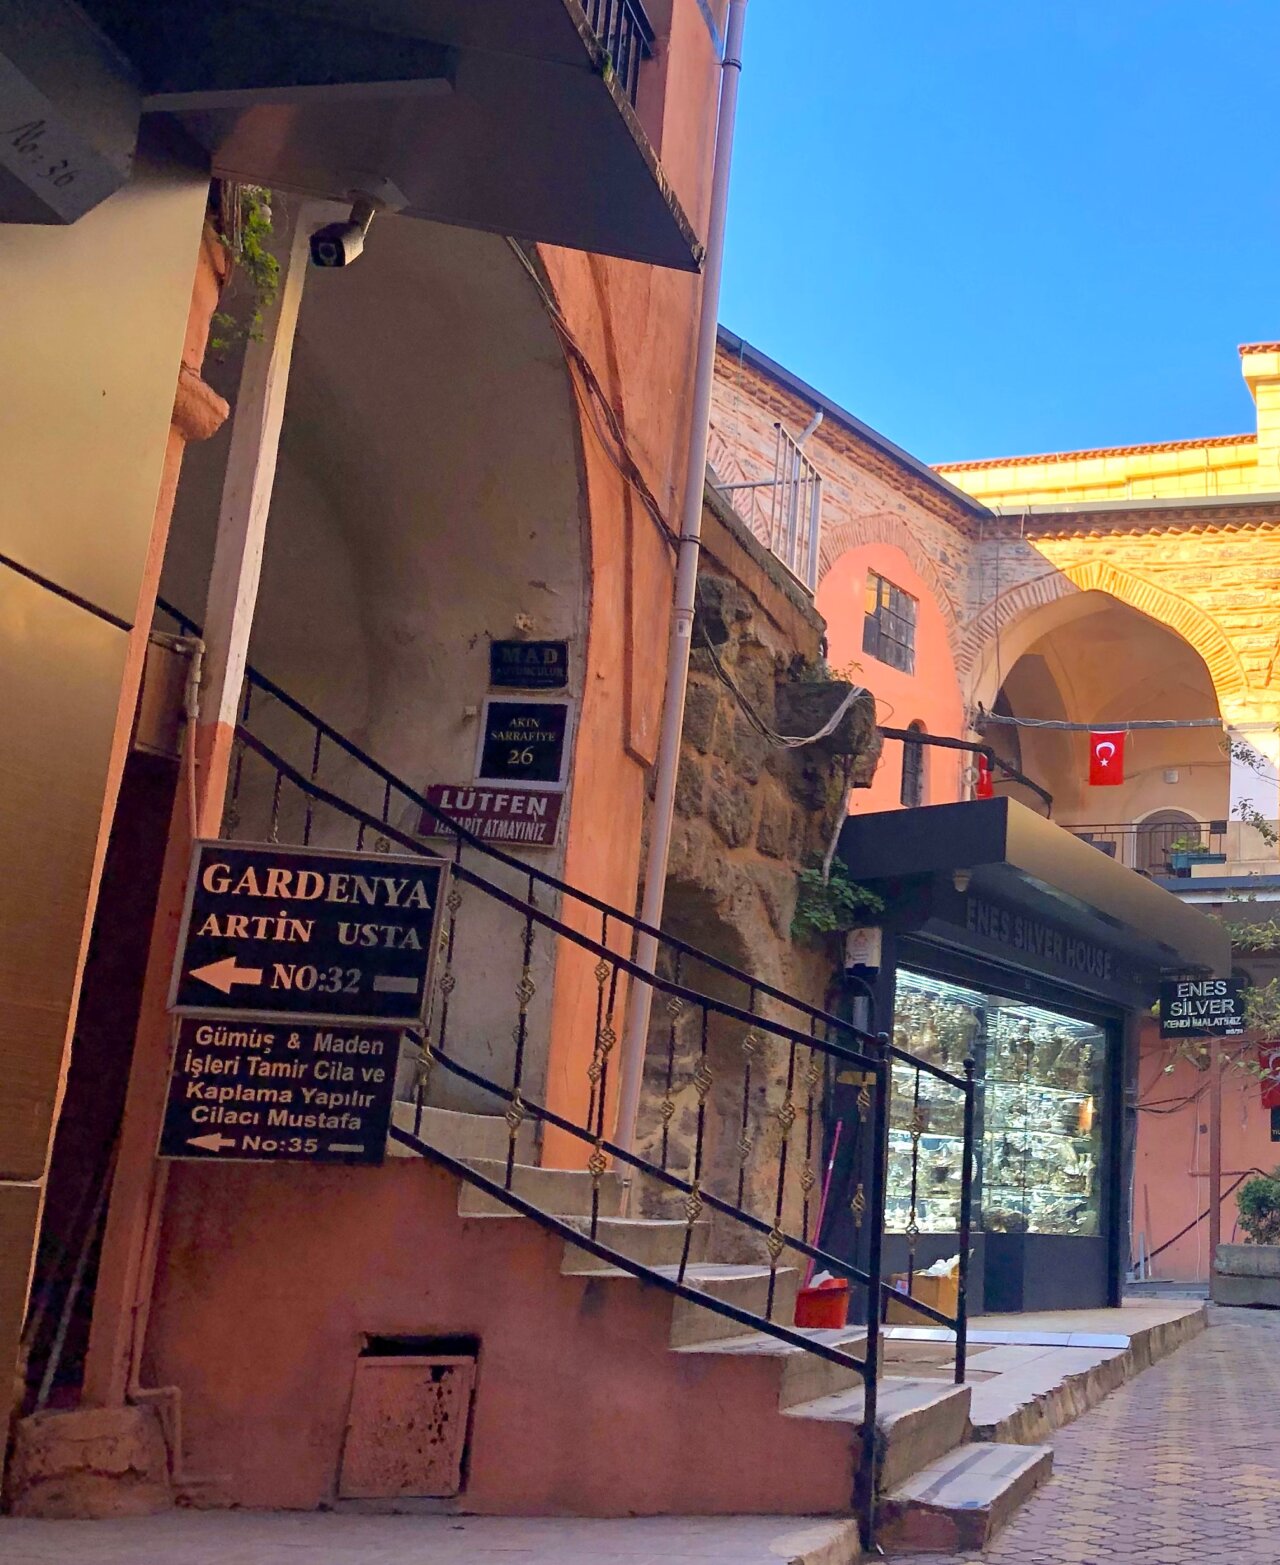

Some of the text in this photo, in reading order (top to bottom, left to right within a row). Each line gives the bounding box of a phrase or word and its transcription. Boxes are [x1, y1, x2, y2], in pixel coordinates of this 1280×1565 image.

[508, 746, 534, 765] 26
[440, 788, 547, 816] LÜTFEN
[483, 817, 546, 841] ATMAYINIZ
[202, 863, 432, 909] GARDENYA
[196, 910, 422, 950] ARTİN USTA
[966, 898, 1010, 943] ENES
[1066, 936, 1112, 981] HOUSE
[270, 964, 361, 993] NO:32
[1177, 981, 1227, 998] ENES
[1170, 998, 1235, 1016] SİLVER
[195, 1024, 384, 1055] Gümüş & Maden
[184, 1049, 385, 1083] İşleri Tamir Cila ve
[186, 1081, 376, 1109] Kaplama Yapılır
[191, 1106, 361, 1130] Cilacı Mustafa
[241, 1135, 318, 1152] No:35
